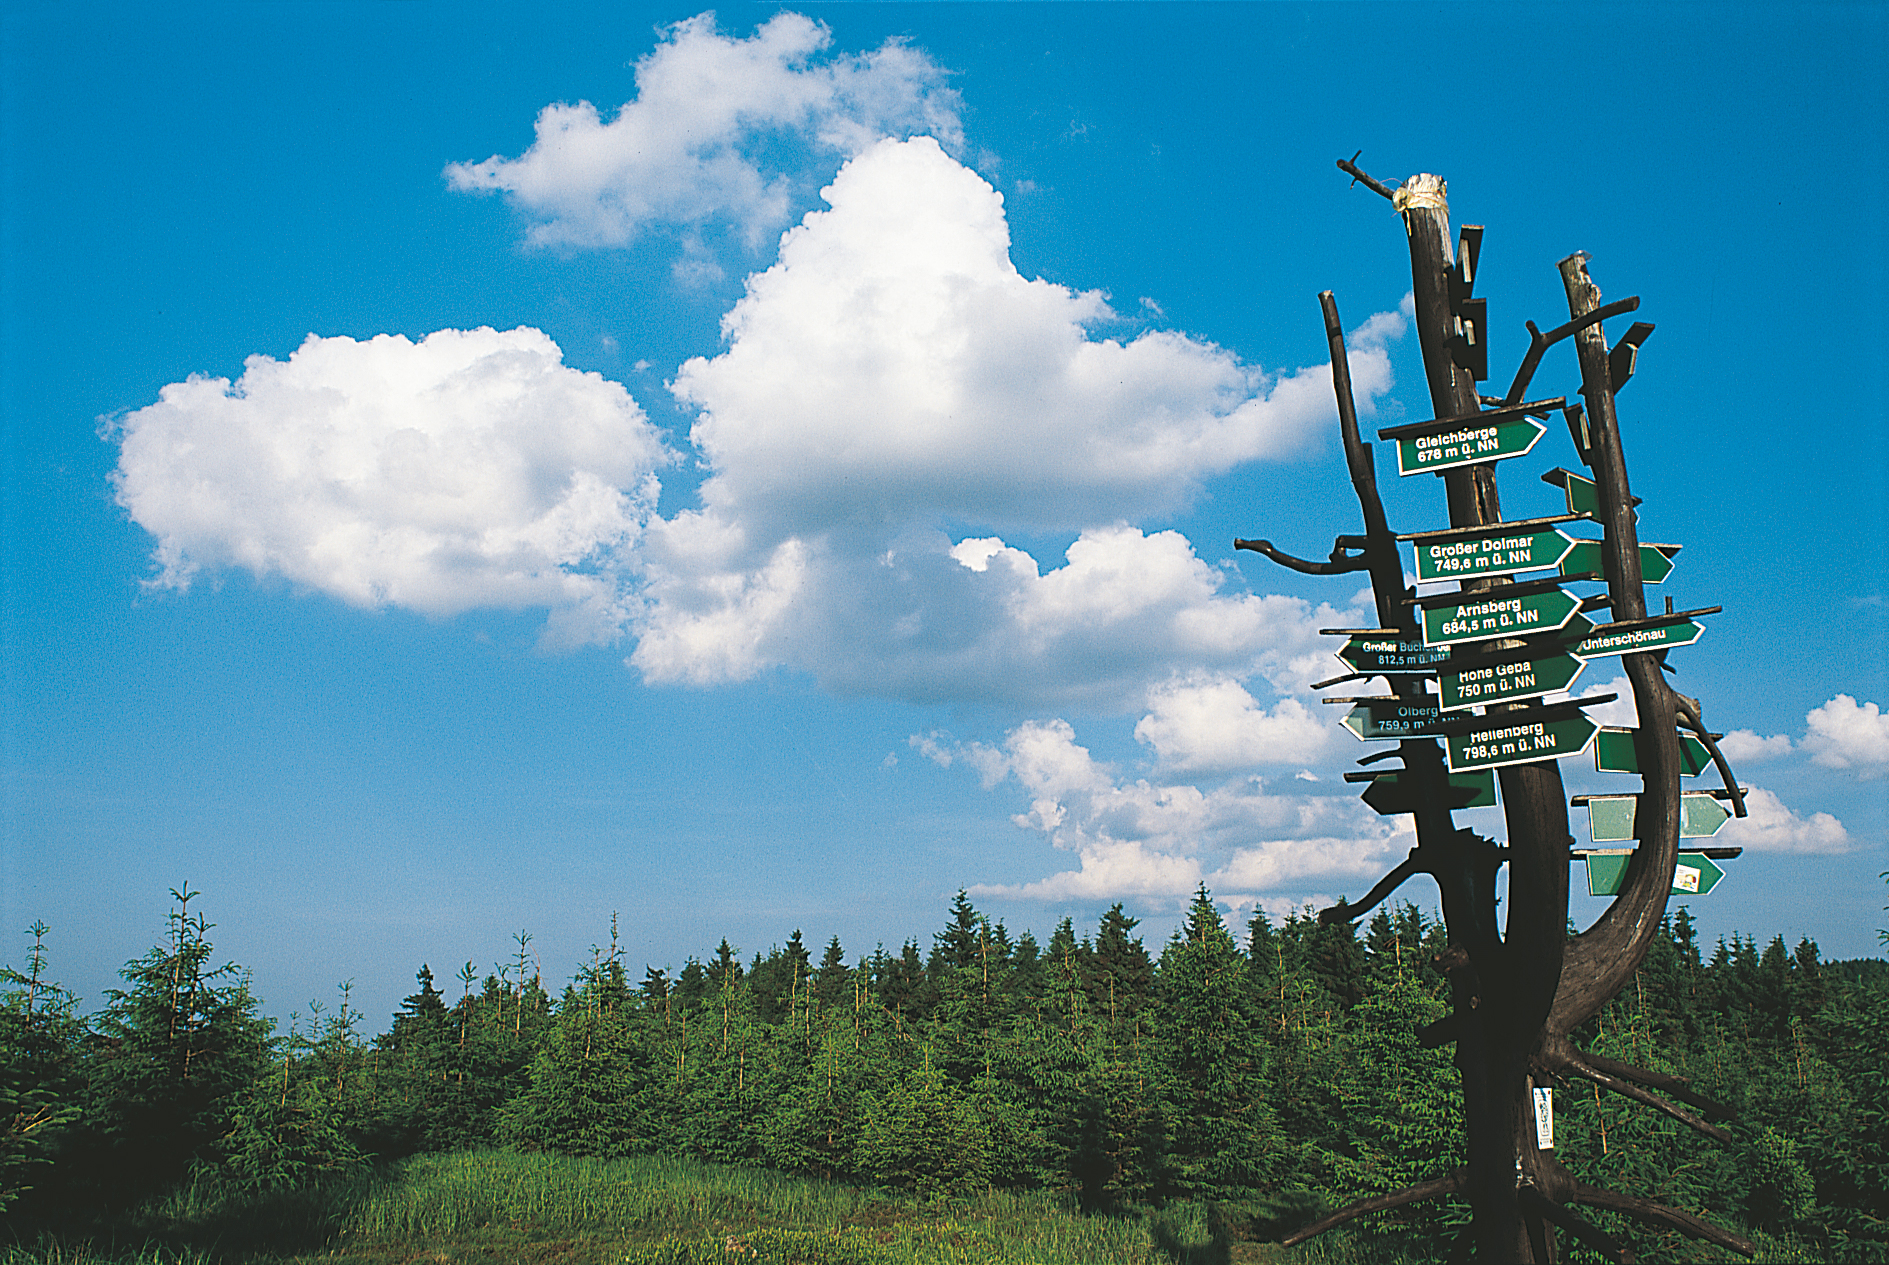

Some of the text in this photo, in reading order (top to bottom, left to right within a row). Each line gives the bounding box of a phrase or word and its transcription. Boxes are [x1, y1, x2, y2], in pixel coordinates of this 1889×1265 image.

[1415, 427, 1498, 449] Gleichberge
[1417, 438, 1499, 462] 678 m ü. NN
[1429, 537, 1533, 558] Großer Dolmar
[1434, 549, 1532, 572] 749,6 m ü. NN
[1456, 599, 1521, 618] Arnsberg
[1442, 609, 1539, 635] 684,5 m ü. NN
[1362, 641, 1397, 653] Großer
[1582, 629, 1667, 650] Unterschönau
[1378, 653, 1446, 666] 812,5 m ü. NN
[1457, 673, 1536, 698] 750 m ü. NN
[1378, 720, 1410, 731] 759,9
[1462, 734, 1556, 760] 798,6 m ü. NN
